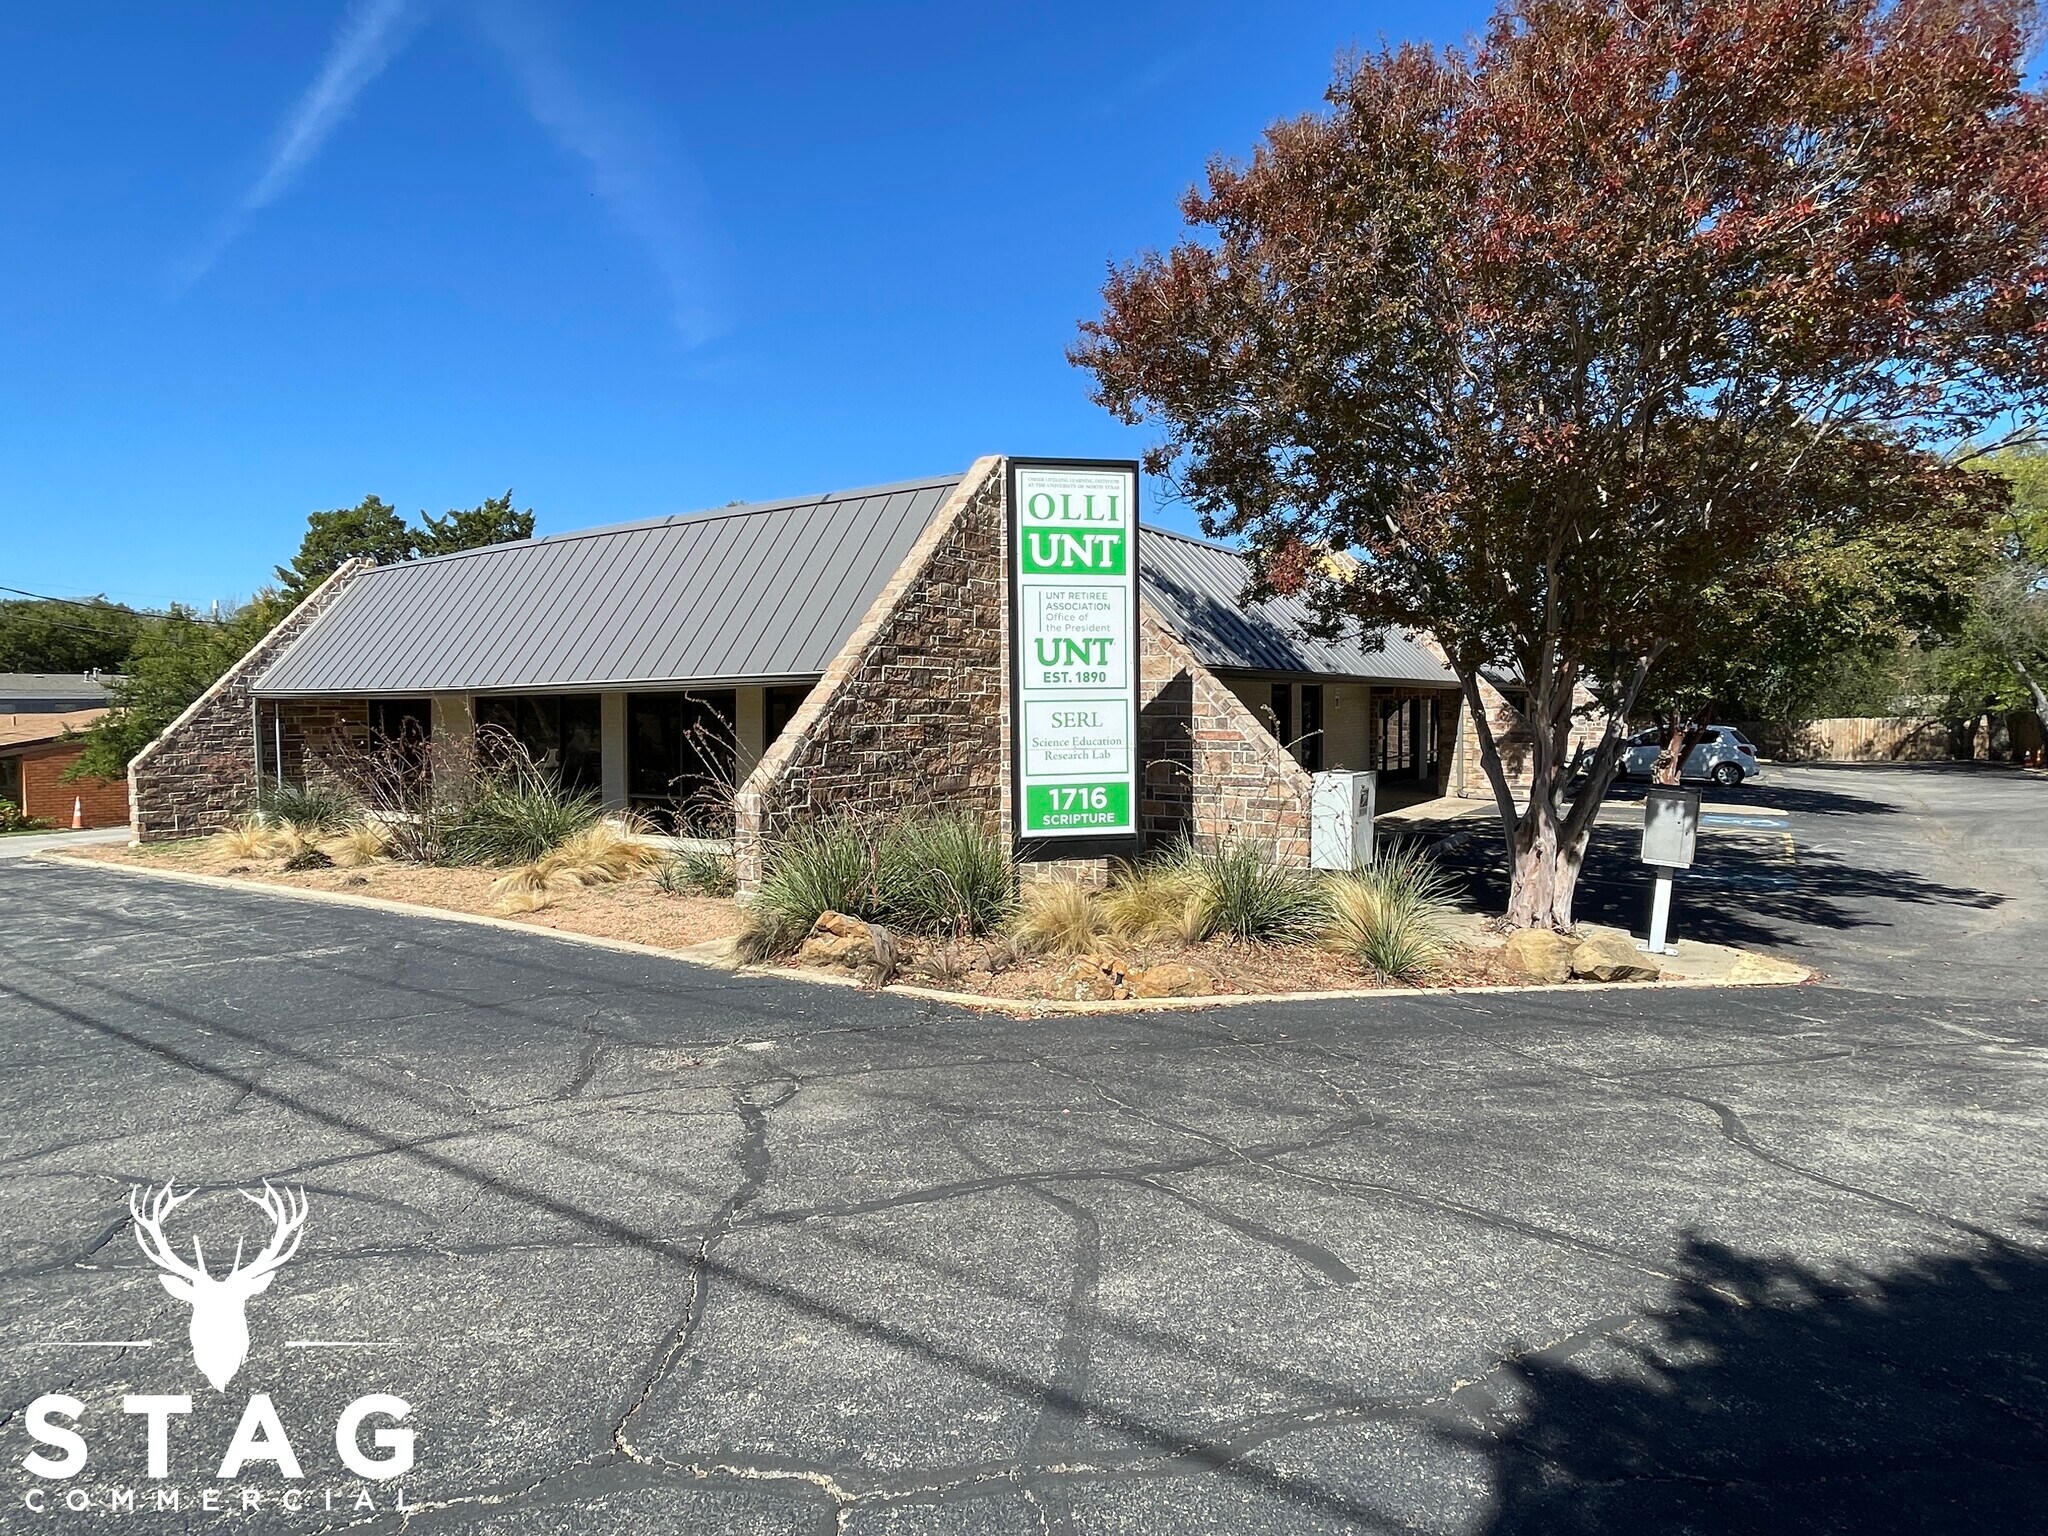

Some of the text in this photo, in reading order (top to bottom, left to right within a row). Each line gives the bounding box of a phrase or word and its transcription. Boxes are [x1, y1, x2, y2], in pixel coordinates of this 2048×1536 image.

[1028, 493, 1119, 521] OLLI
[1028, 533, 1120, 567] UNT
[1046, 592, 1108, 600] UNT RETIREE
[1046, 603, 1111, 611] ASSOCIATION
[1046, 613, 1089, 621] Office of
[1046, 624, 1110, 632] the President
[1034, 638, 1114, 666] UNT
[1043, 672, 1106, 683] EST. 1890
[1051, 712, 1103, 728] SERL
[1032, 737, 1122, 748] Science Education
[1045, 749, 1111, 760] Research Lab
[1048, 787, 1108, 811] 1716
[1042, 813, 1115, 825] SCRIPTURE
